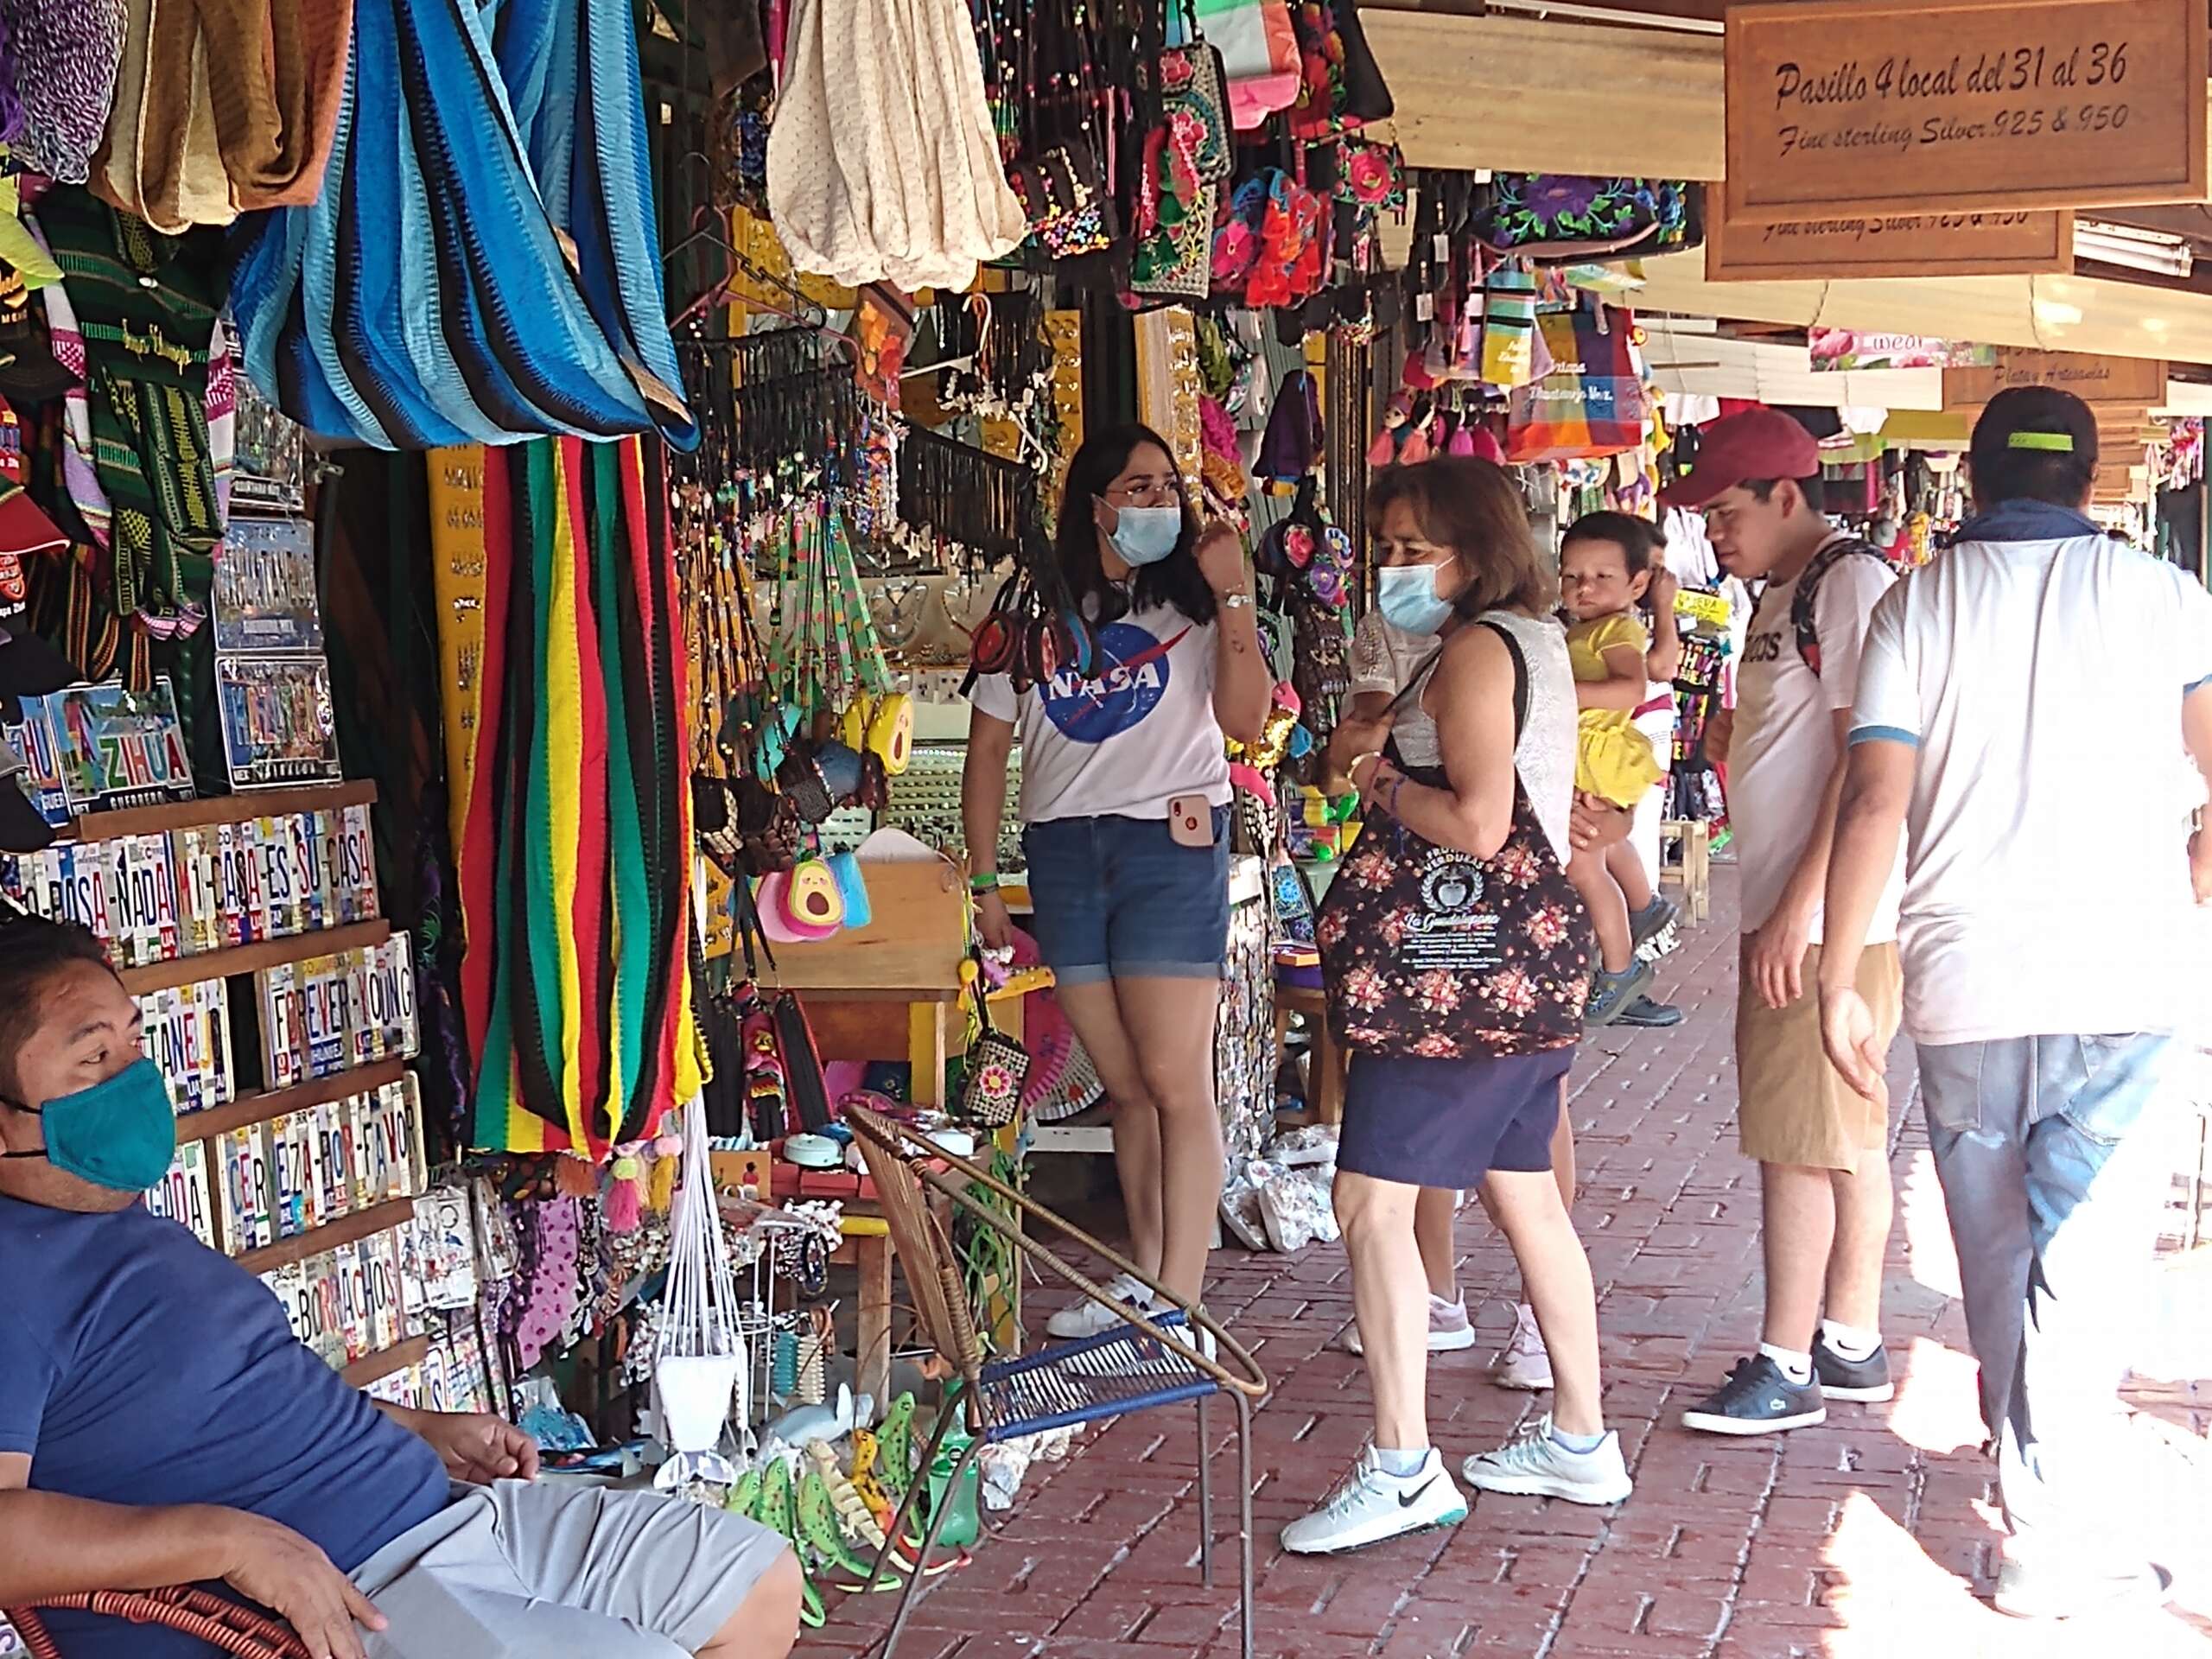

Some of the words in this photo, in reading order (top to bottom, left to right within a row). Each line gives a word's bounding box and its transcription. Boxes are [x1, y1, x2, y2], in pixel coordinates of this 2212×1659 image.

[1776, 61, 1867, 111] Pasillo
[1875, 56, 1894, 99] 4
[1899, 57, 1960, 98] local
[1967, 53, 2006, 93] del
[2010, 46, 2044, 90] 31
[2052, 47, 2080, 86] al
[2087, 42, 2128, 84] 36
[1778, 125, 1826, 157] Fine
[1833, 122, 1913, 152] sterling
[1919, 118, 1985, 143] Silver
[2051, 106, 2068, 132] &
[1049, 662, 1160, 701] NASA
[99, 733, 188, 790] ZIHUA
